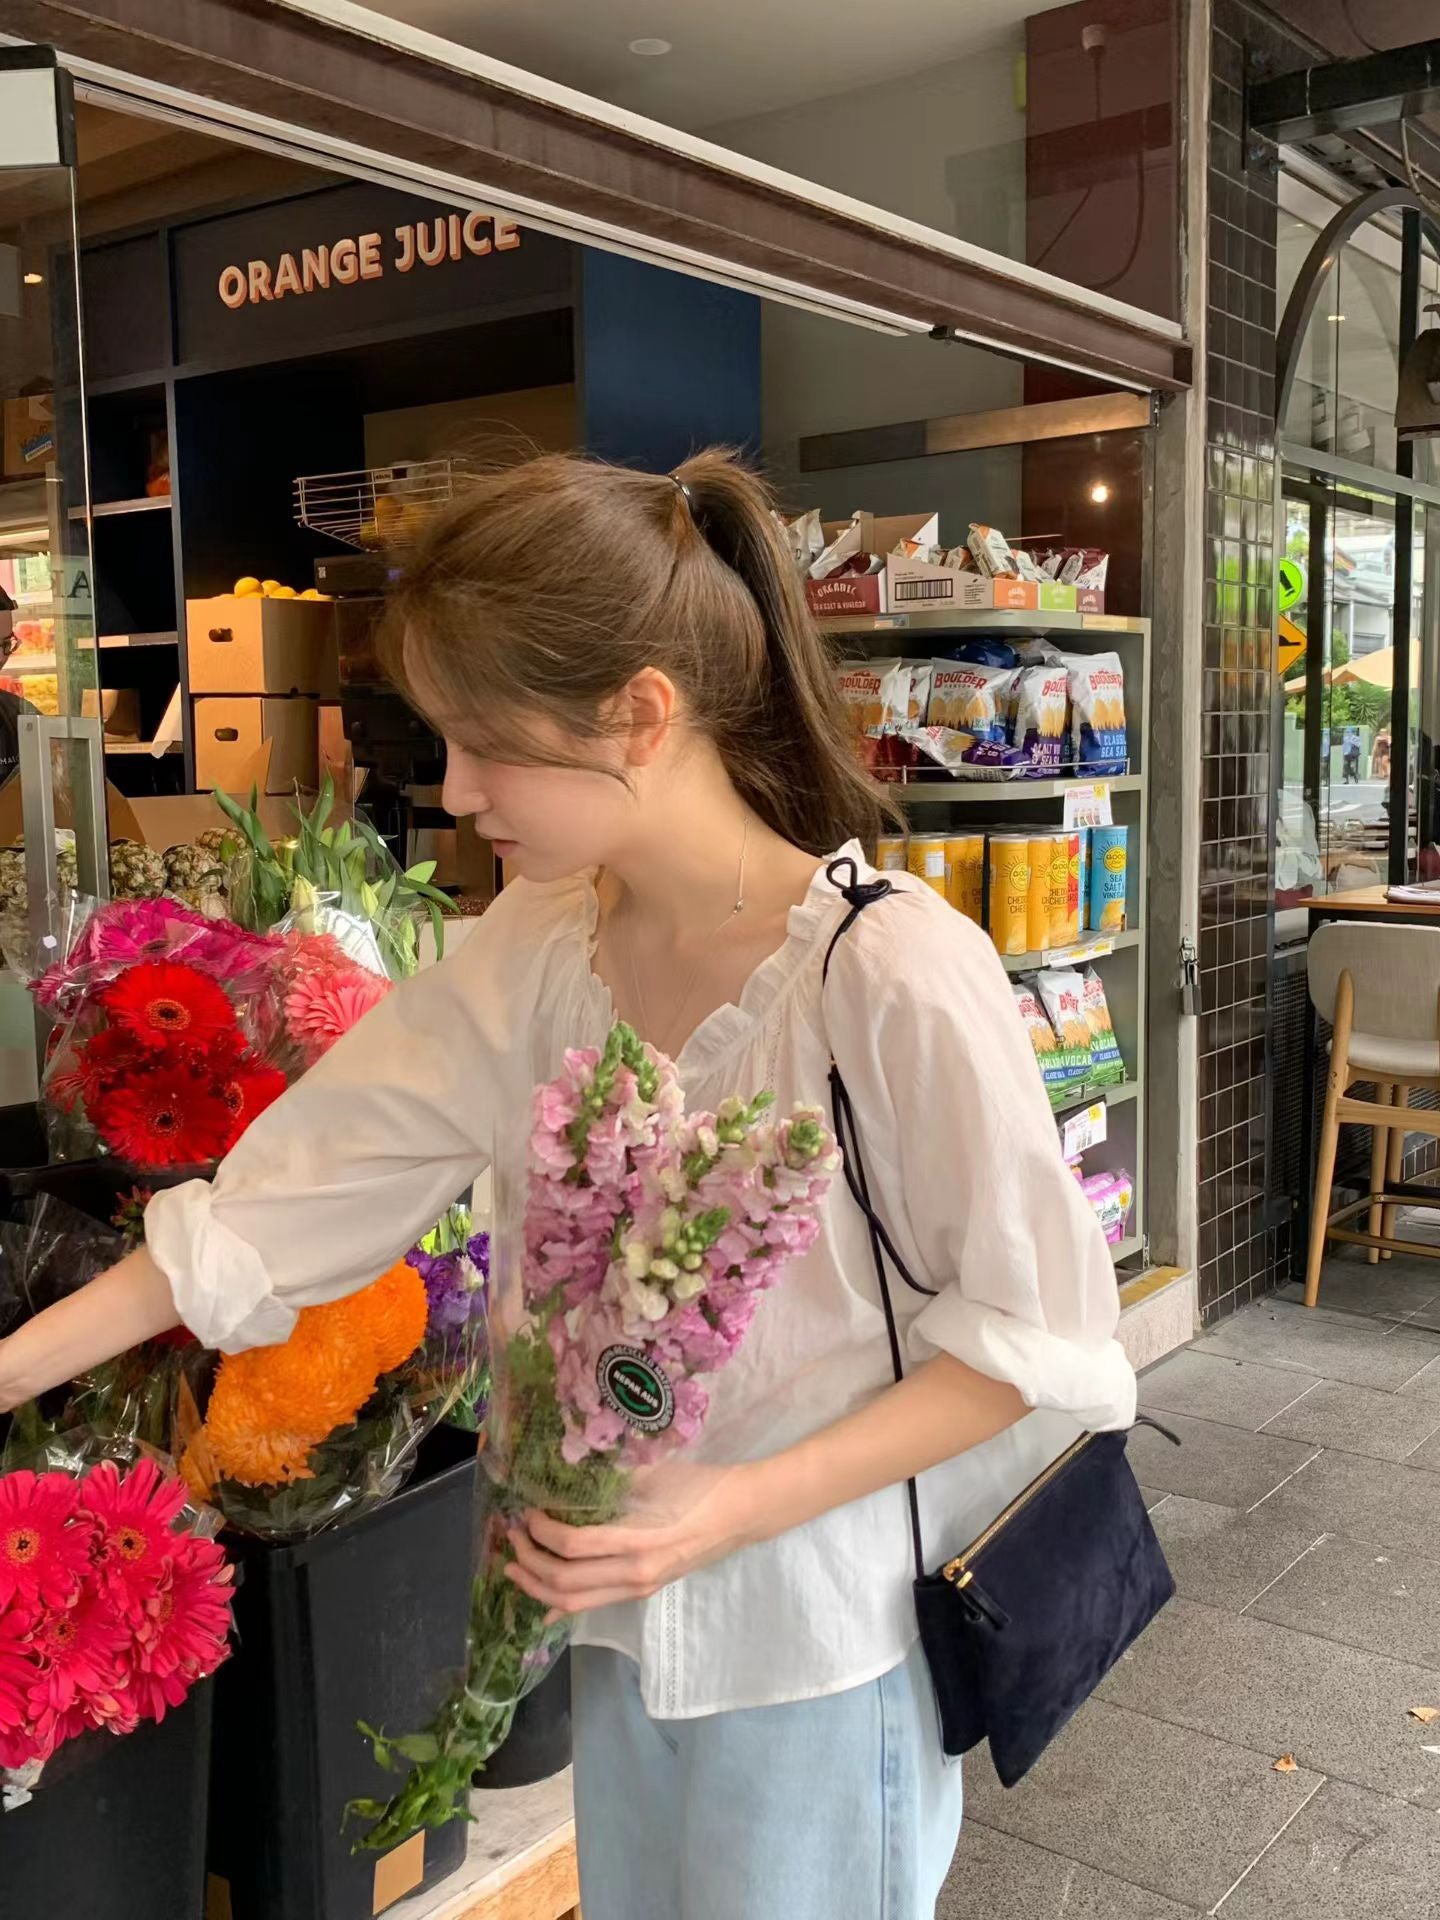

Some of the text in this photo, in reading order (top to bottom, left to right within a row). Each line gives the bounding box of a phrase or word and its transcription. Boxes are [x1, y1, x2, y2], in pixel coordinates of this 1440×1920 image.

[218, 210, 521, 309] ORANGE JUICE
[934, 672, 988, 690] BOULDER
[1109, 874, 1123, 883] SEA
[1104, 882, 1121, 891] SALT
